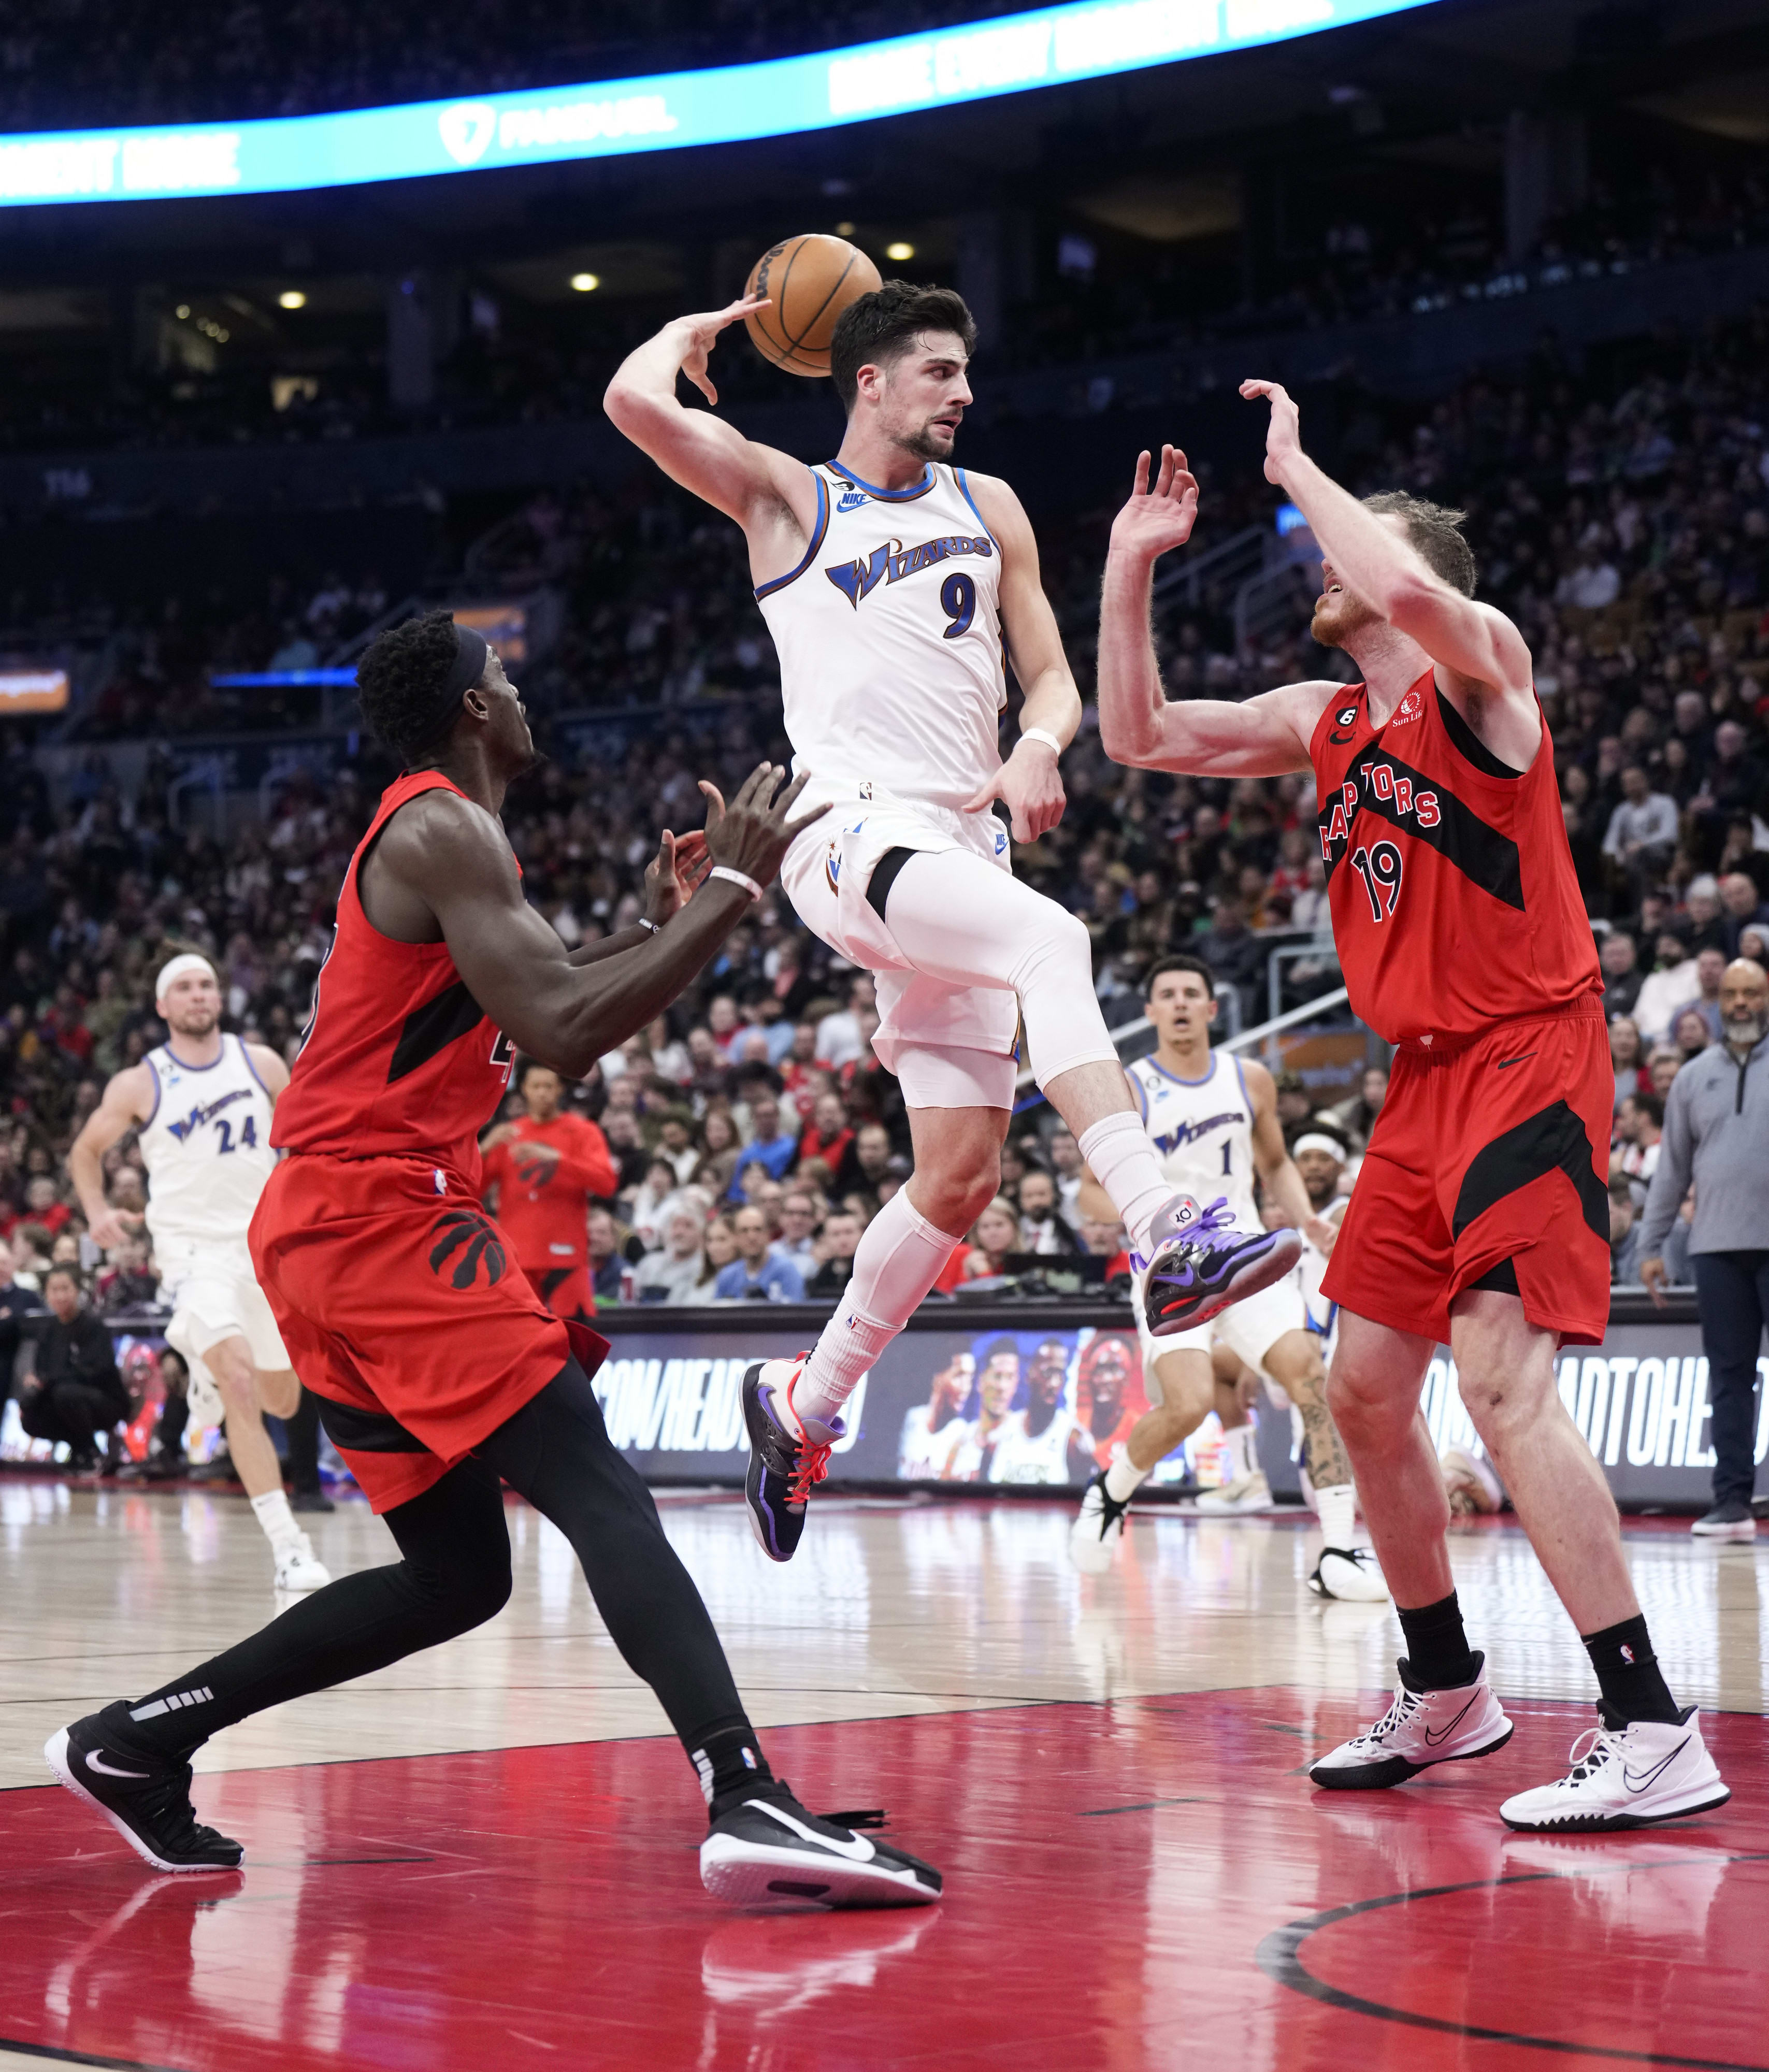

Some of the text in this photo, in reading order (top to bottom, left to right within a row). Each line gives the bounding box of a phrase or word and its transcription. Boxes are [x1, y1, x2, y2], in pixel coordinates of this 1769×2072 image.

[841, 493, 867, 505] NIKE
[825, 536, 993, 612] WIZARDS
[940, 572, 976, 639] 9
[1340, 709, 1356, 725] 6
[1392, 717, 1408, 727] Sun
[1350, 840, 1403, 923] 19
[214, 1115, 257, 1156] 24
[1220, 1138, 1232, 1175] 1
